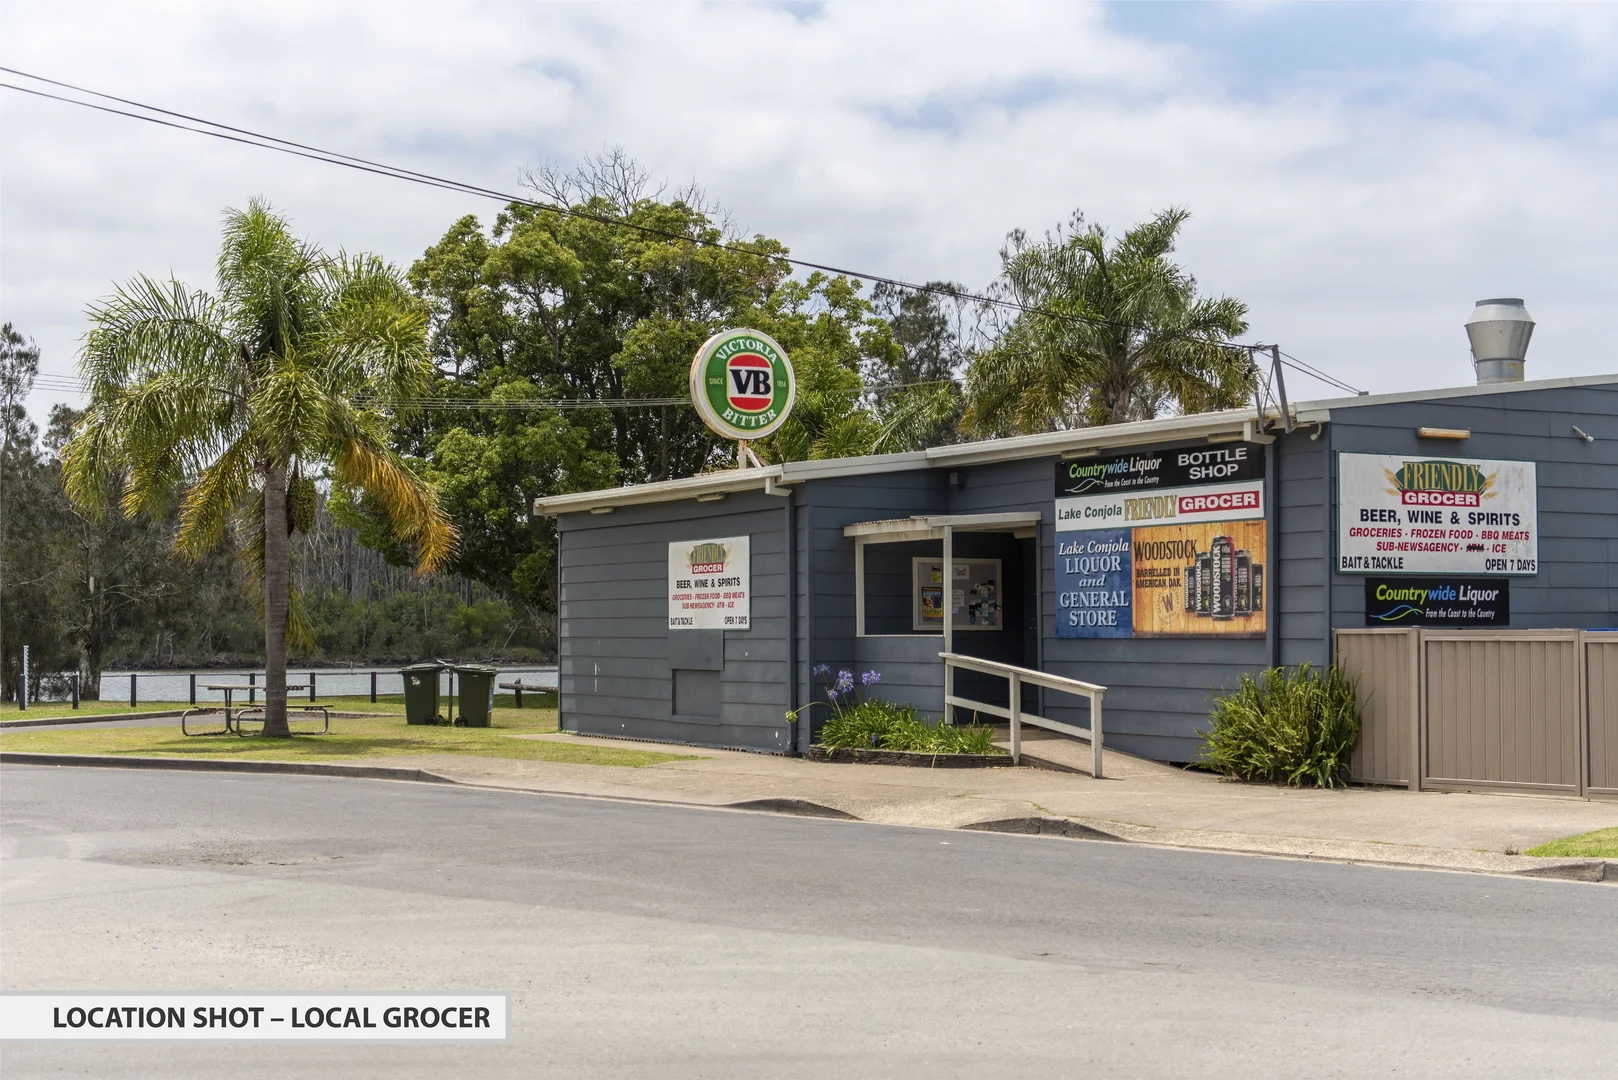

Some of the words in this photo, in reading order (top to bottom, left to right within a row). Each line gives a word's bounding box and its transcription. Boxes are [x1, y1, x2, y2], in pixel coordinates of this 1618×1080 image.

[716, 339, 778, 364] VICTORIA
[729, 369, 771, 395] VB
[722, 408, 776, 426] BITTER
[1178, 448, 1248, 466] BOTTLE
[1069, 458, 1128, 479] Countrywide
[1129, 456, 1162, 475] Liquor
[1189, 464, 1239, 480] SHOP
[1121, 478, 1131, 486] Coast
[1144, 476, 1160, 484] Country
[1402, 461, 1480, 492] FRIENDLY
[1404, 492, 1477, 505] GROCER
[1058, 506, 1081, 520] Lake
[1084, 504, 1122, 521] Conjola
[1124, 495, 1178, 522] FRIENDLY
[1182, 493, 1256, 510] GROCER
[1360, 509, 1401, 525] BEER,
[1408, 510, 1442, 524] WINE
[1450, 512, 1460, 525] &
[1468, 512, 1520, 526] SPIRITS
[1350, 528, 1402, 538] GROCERIES
[1411, 529, 1446, 538] FROZEN
[1449, 530, 1473, 539] FOOD
[1481, 530, 1499, 540] BBQ
[1502, 531, 1530, 540] MEATS
[693, 544, 724, 564] FRIENDLY
[1059, 542, 1084, 556] Lake
[1087, 538, 1129, 556] Conjola
[1134, 539, 1198, 562] WOODSTOCK
[1376, 541, 1460, 552] SUB-NEWSAGENCY
[1492, 544, 1506, 553] ICE
[694, 564, 722, 573] GROCER
[1066, 556, 1122, 574] LIQUOR
[1342, 556, 1362, 568] BAIT
[1364, 557, 1370, 569] &
[1371, 557, 1404, 569] TACKLE
[1485, 559, 1507, 570] OPEN
[1510, 560, 1514, 570] 7
[1517, 560, 1536, 571] DAYS
[1079, 574, 1106, 588] and
[1136, 568, 1171, 577] BARRELLED
[1174, 568, 1180, 576] IN
[1213, 545, 1221, 613] WOODSTOCK
[676, 580, 692, 590] BEER,
[694, 579, 708, 588] WINE
[711, 579, 715, 588] &
[718, 577, 740, 587] SPIRITS
[1136, 578, 1166, 588] AMERICAN
[1060, 590, 1129, 608] GENERAL
[1376, 584, 1456, 605] Countrywide
[1459, 585, 1498, 605] Liquor
[724, 616, 734, 624] OPEN
[738, 616, 747, 624] DAYS
[1070, 610, 1118, 627] STORE
[1426, 608, 1438, 618] From
[1448, 608, 1460, 618] Coast
[1462, 609, 1467, 617] to
[1477, 608, 1495, 619] Country
